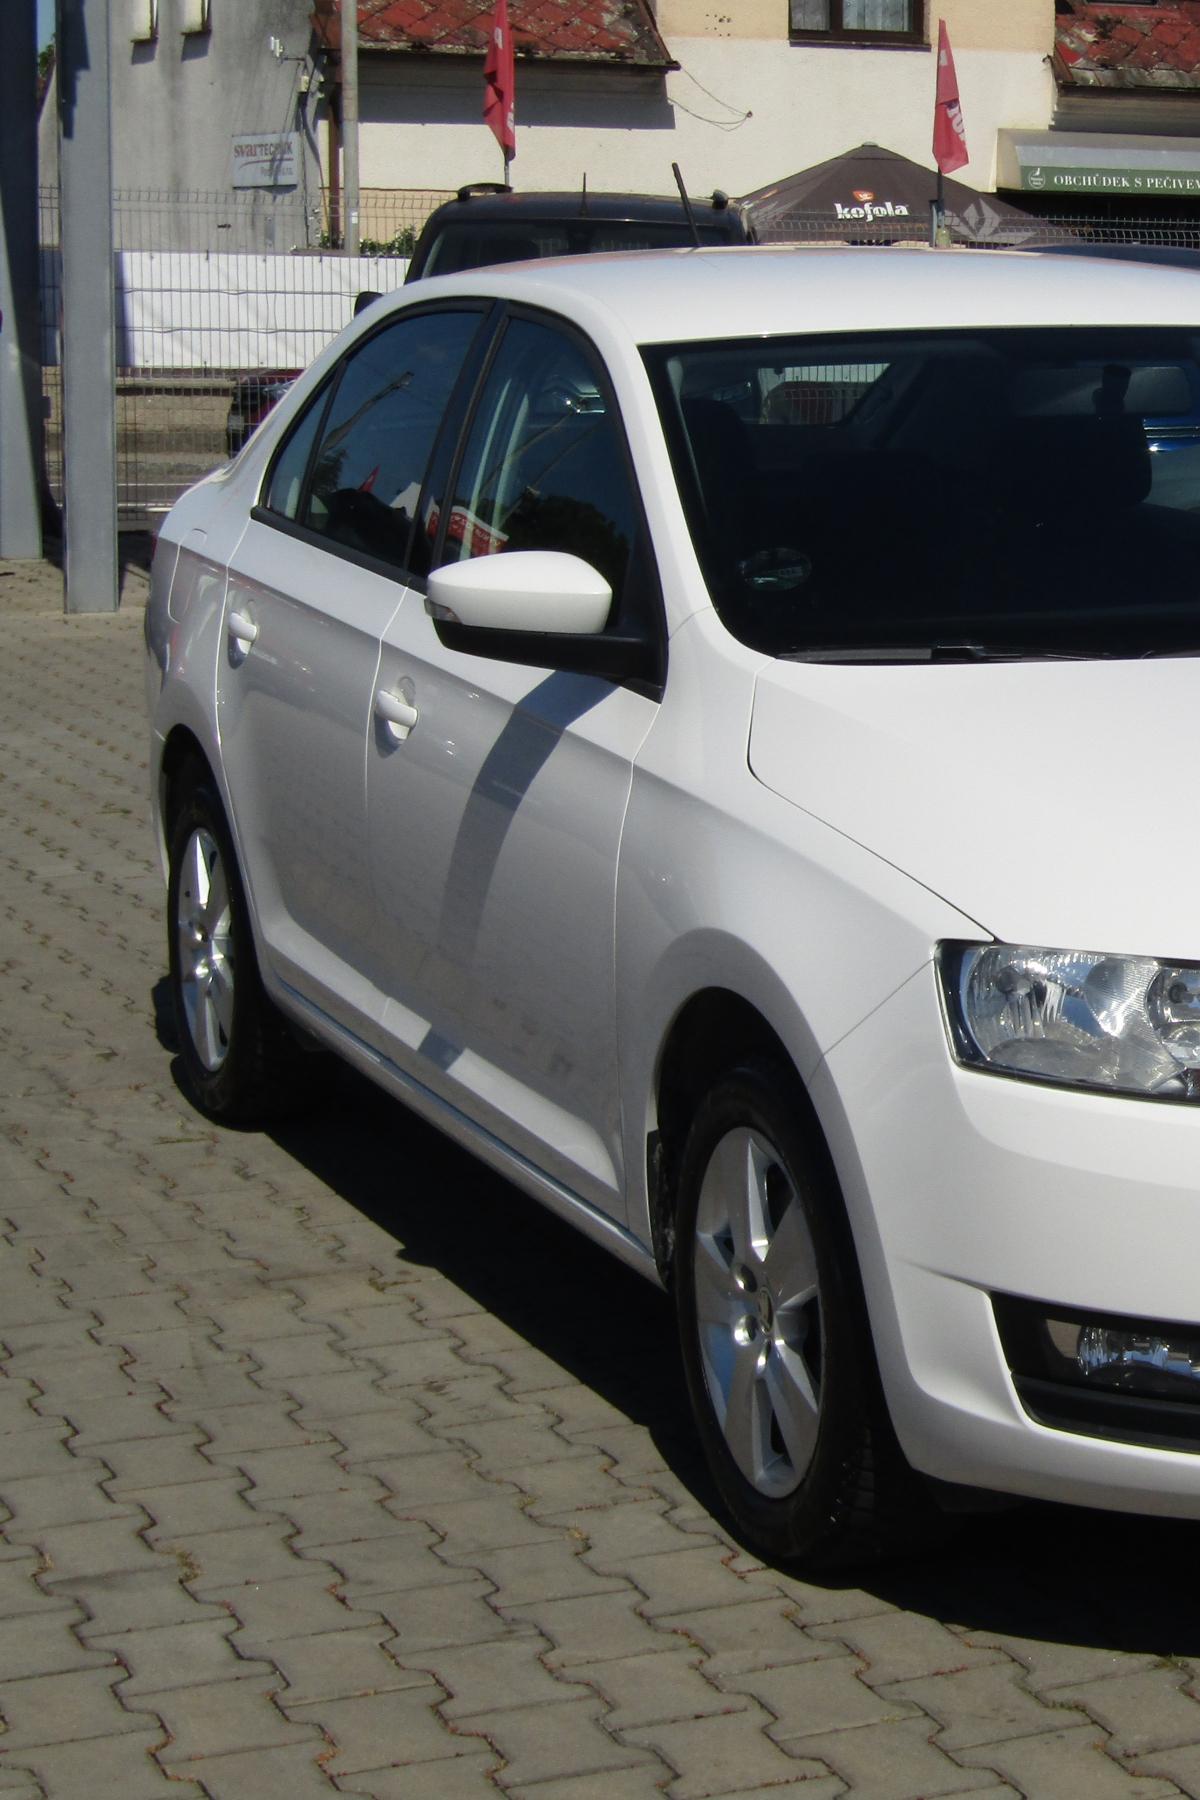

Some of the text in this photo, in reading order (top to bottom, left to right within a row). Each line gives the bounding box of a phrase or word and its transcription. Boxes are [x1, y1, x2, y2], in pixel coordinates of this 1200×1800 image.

[1053, 173, 1130, 188] OBCHŮDEK
[1134, 176, 1142, 188] S
[833, 201, 910, 222] kofola
